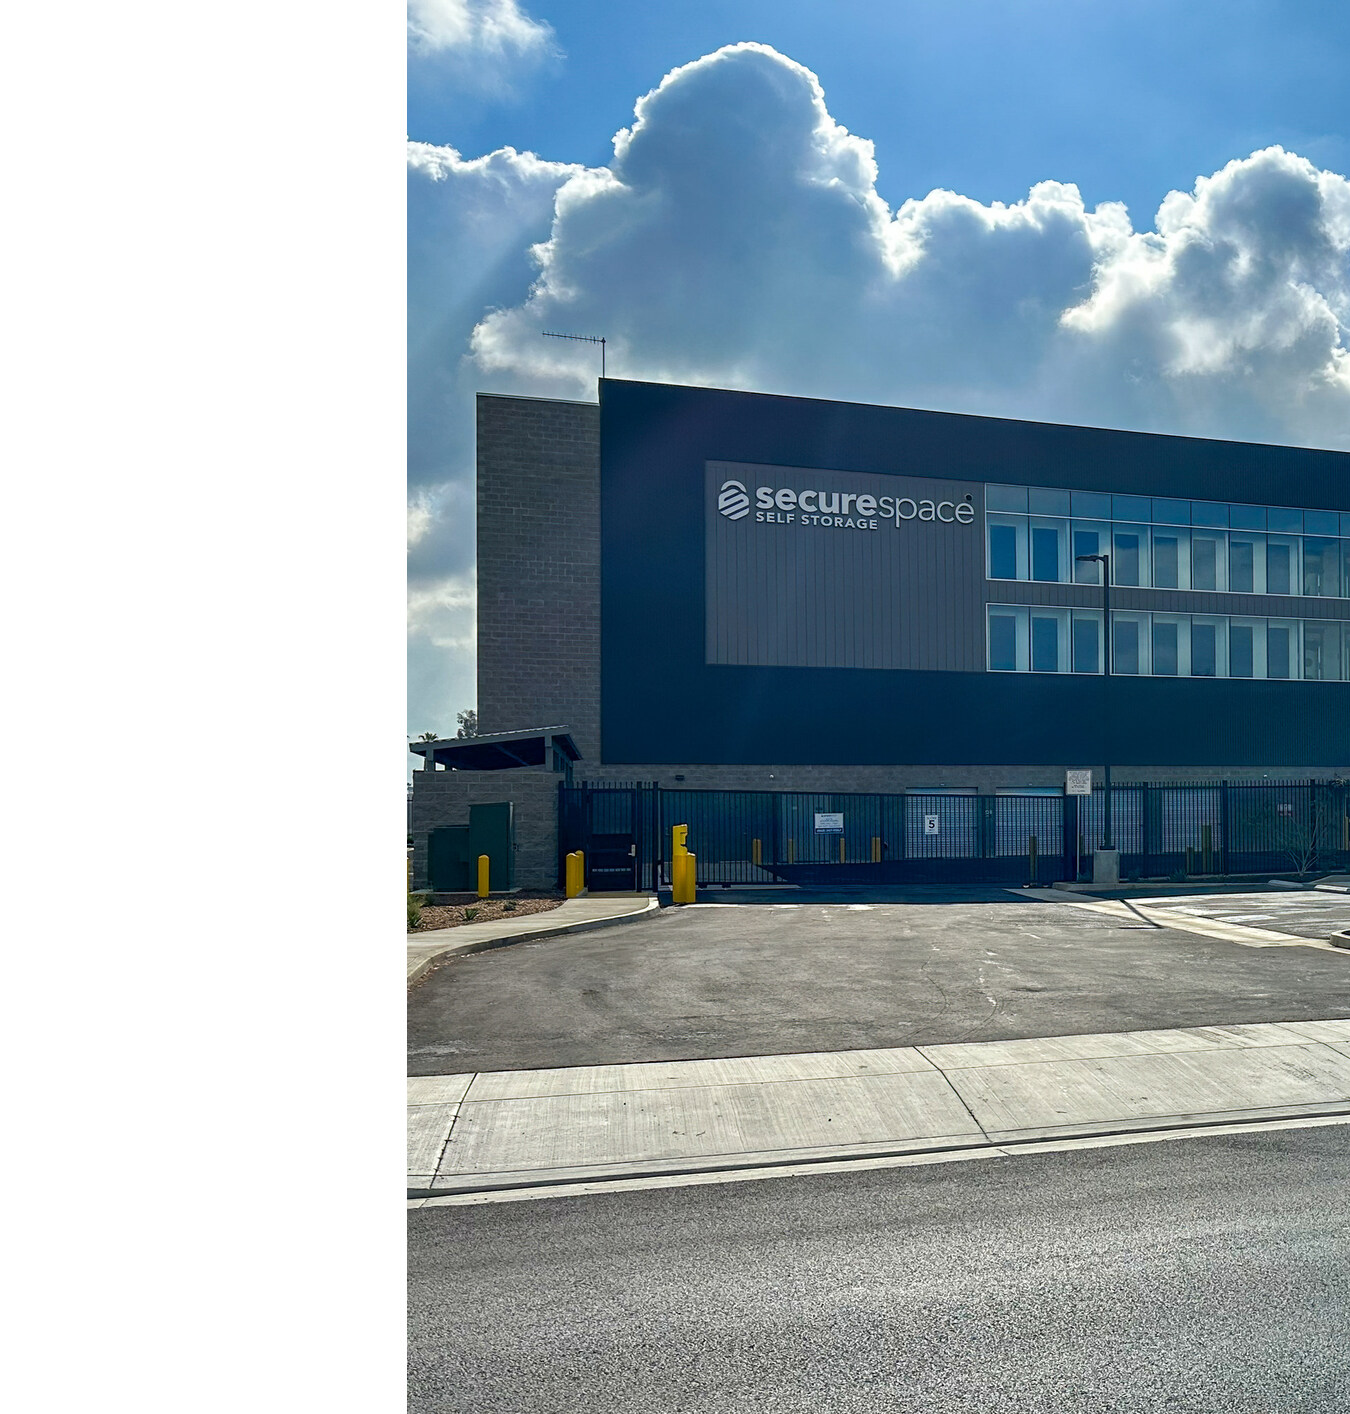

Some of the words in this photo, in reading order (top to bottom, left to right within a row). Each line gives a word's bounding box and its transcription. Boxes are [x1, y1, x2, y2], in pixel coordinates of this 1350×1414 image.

[755, 486, 975, 528] securespace
[755, 511, 796, 524] SELF
[801, 515, 878, 530] STORAGE
[928, 819, 935, 828] 5
